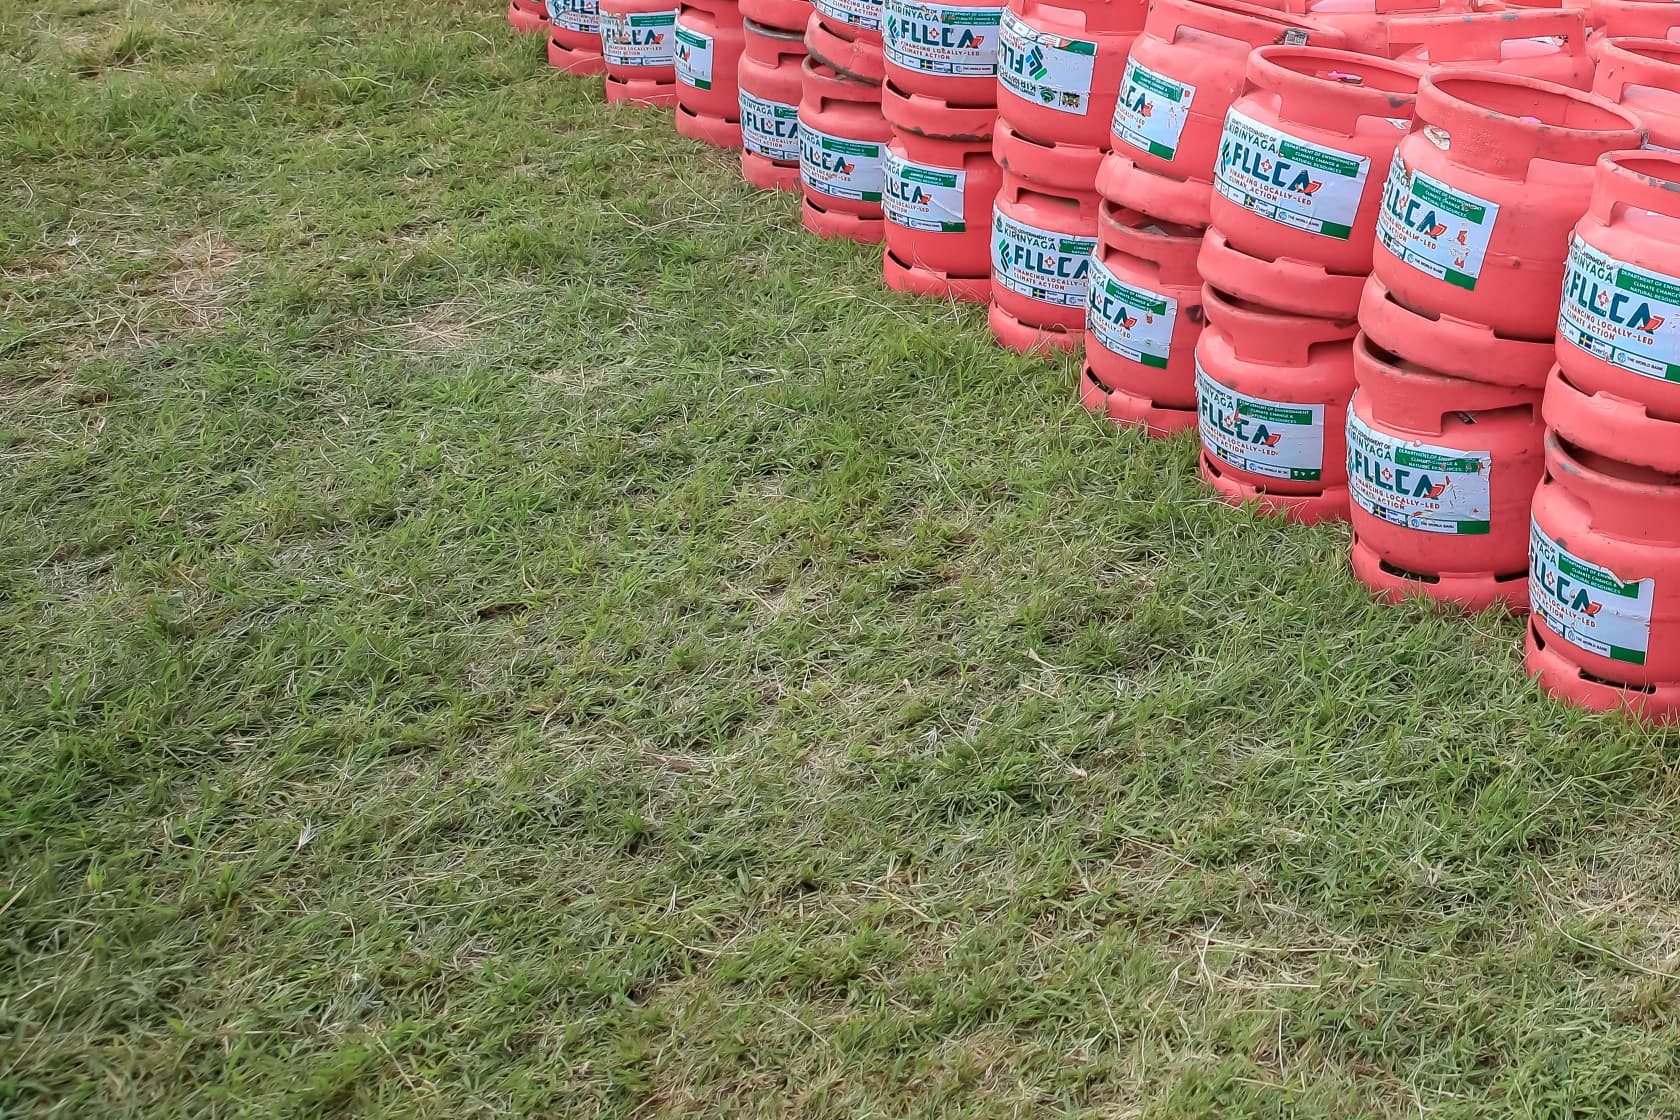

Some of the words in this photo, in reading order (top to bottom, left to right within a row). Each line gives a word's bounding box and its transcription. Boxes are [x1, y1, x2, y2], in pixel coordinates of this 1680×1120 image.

[1229, 123, 1276, 154] KIRINYAGA
[1250, 186, 1278, 202] ACTION
[1259, 183, 1312, 206] LOCALLY-LED
[1004, 227, 1057, 251] KIRINYAGA
[1014, 273, 1037, 286] CLIMATE
[1039, 281, 1065, 290] ACTION
[1587, 323, 1616, 340] ACTION
[1597, 317, 1654, 345] LOCALLY-LED
[1377, 496, 1405, 510] ACTION
[1386, 492, 1440, 509] LOCALLY-LED
